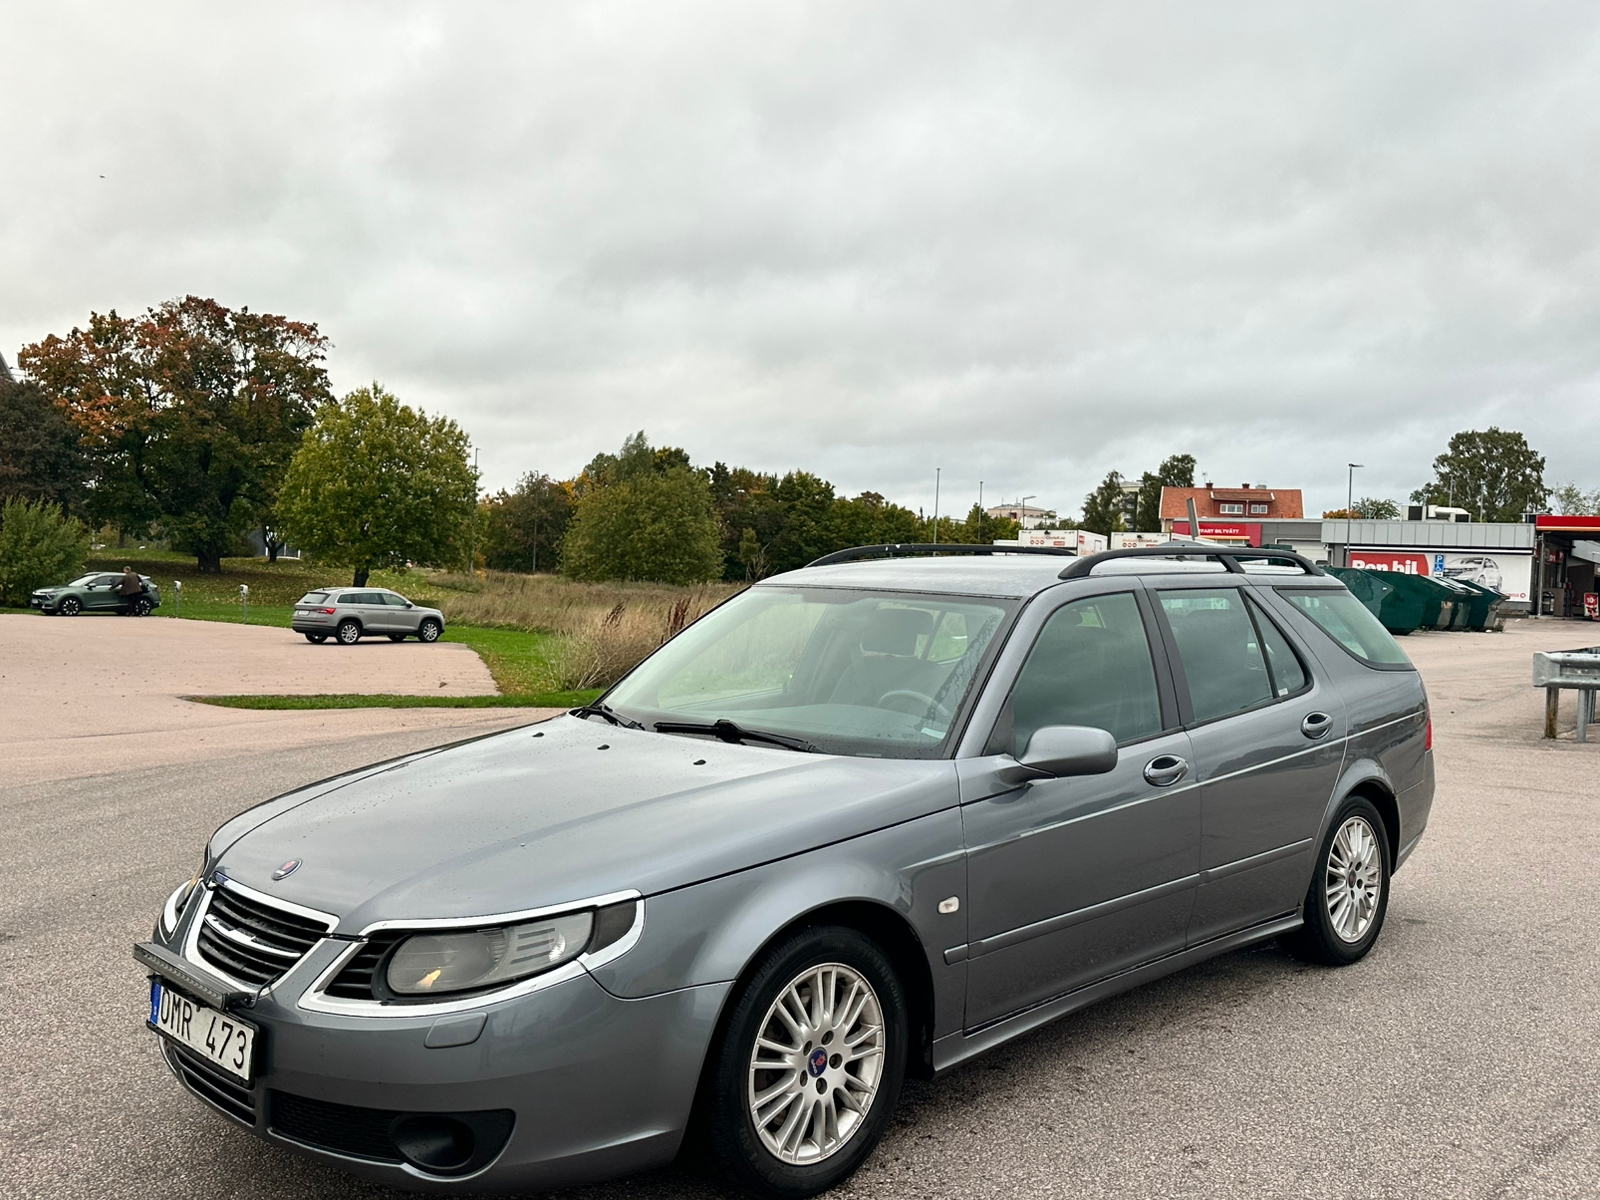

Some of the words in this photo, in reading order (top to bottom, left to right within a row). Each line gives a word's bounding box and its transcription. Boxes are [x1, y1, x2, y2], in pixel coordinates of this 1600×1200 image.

[1436, 555, 1443, 563] P
[160, 988, 193, 1041] OMR
[205, 1016, 247, 1069] 473
